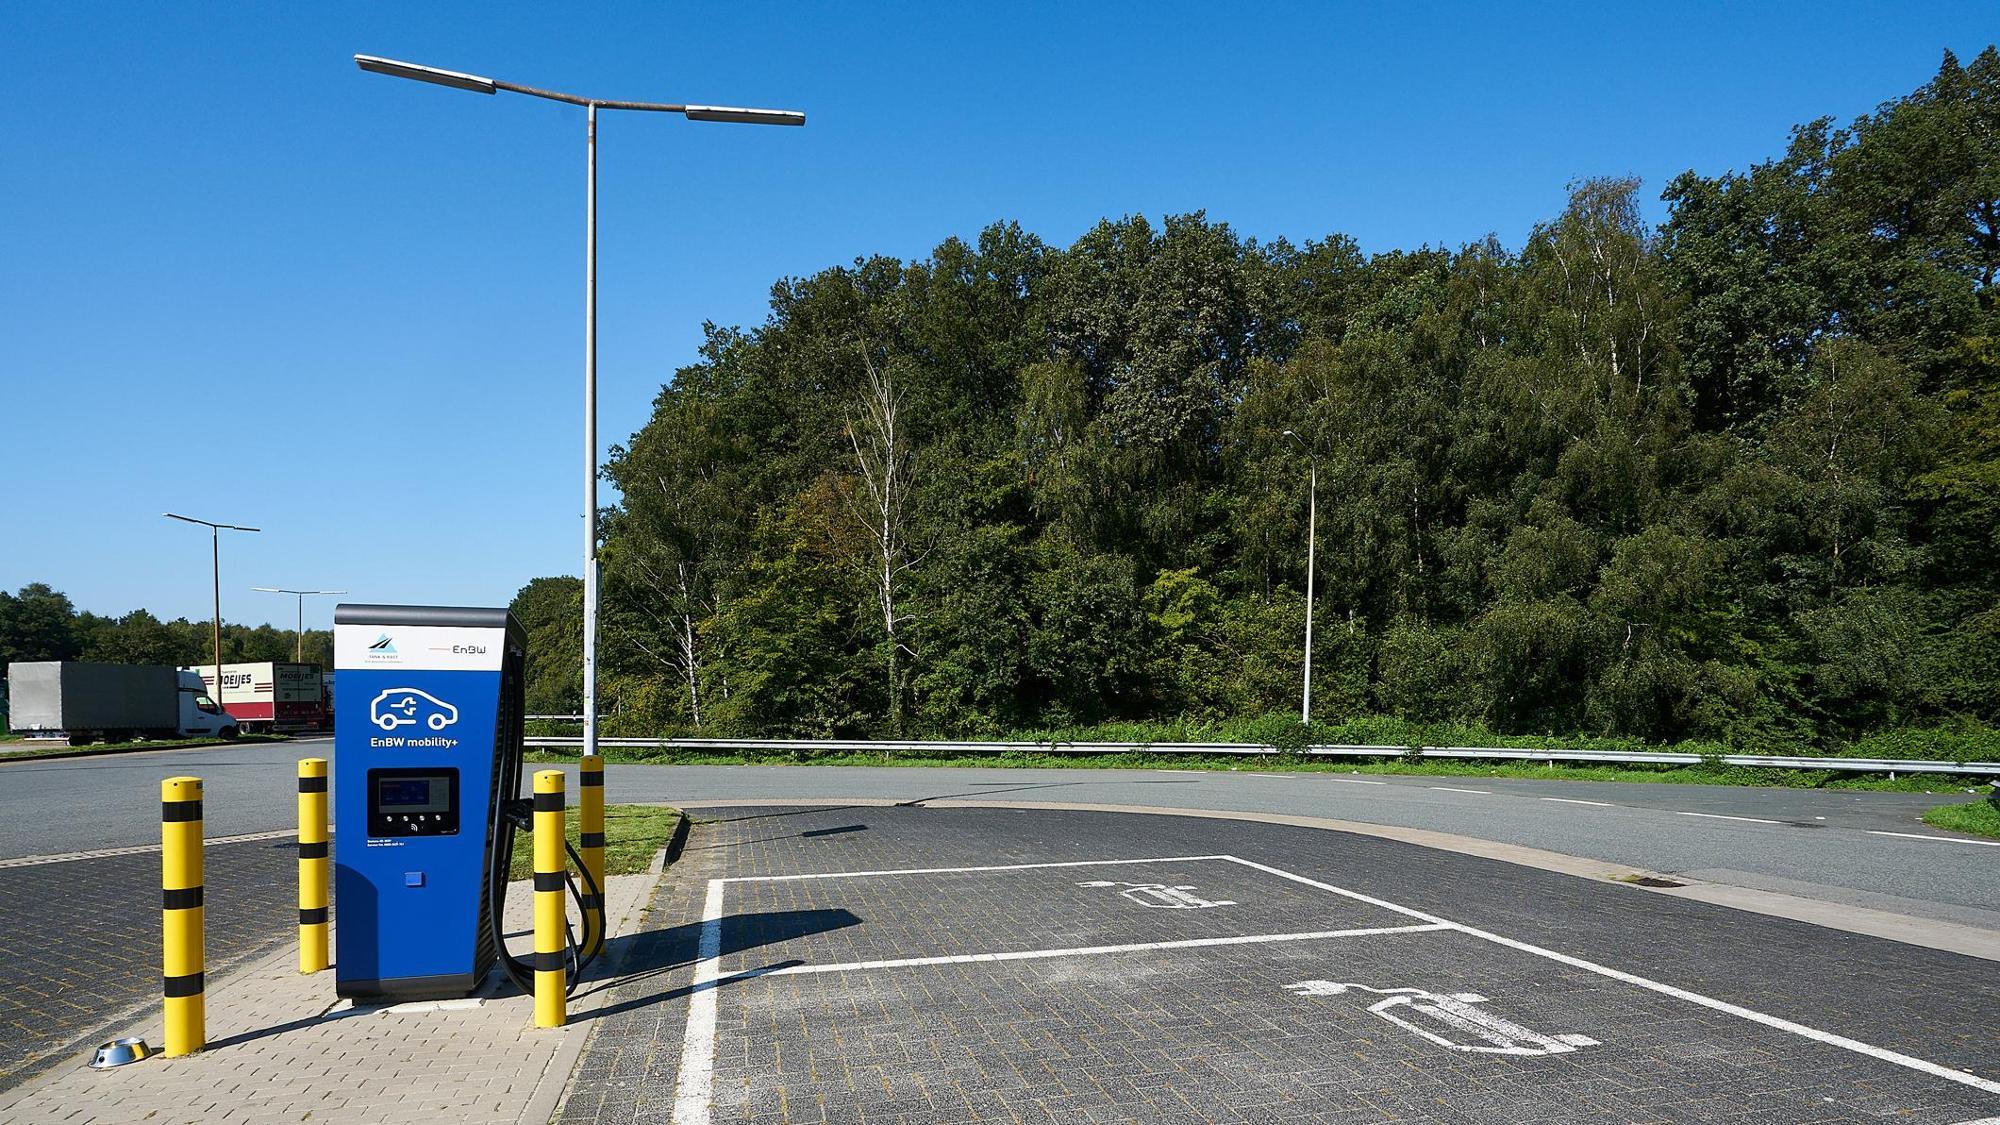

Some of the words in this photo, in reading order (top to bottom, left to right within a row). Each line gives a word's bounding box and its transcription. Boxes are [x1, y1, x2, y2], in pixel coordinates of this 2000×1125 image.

[452, 645, 486, 654] EnBW
[370, 737, 405, 747] EnBW
[407, 737, 458, 749] mobility+
